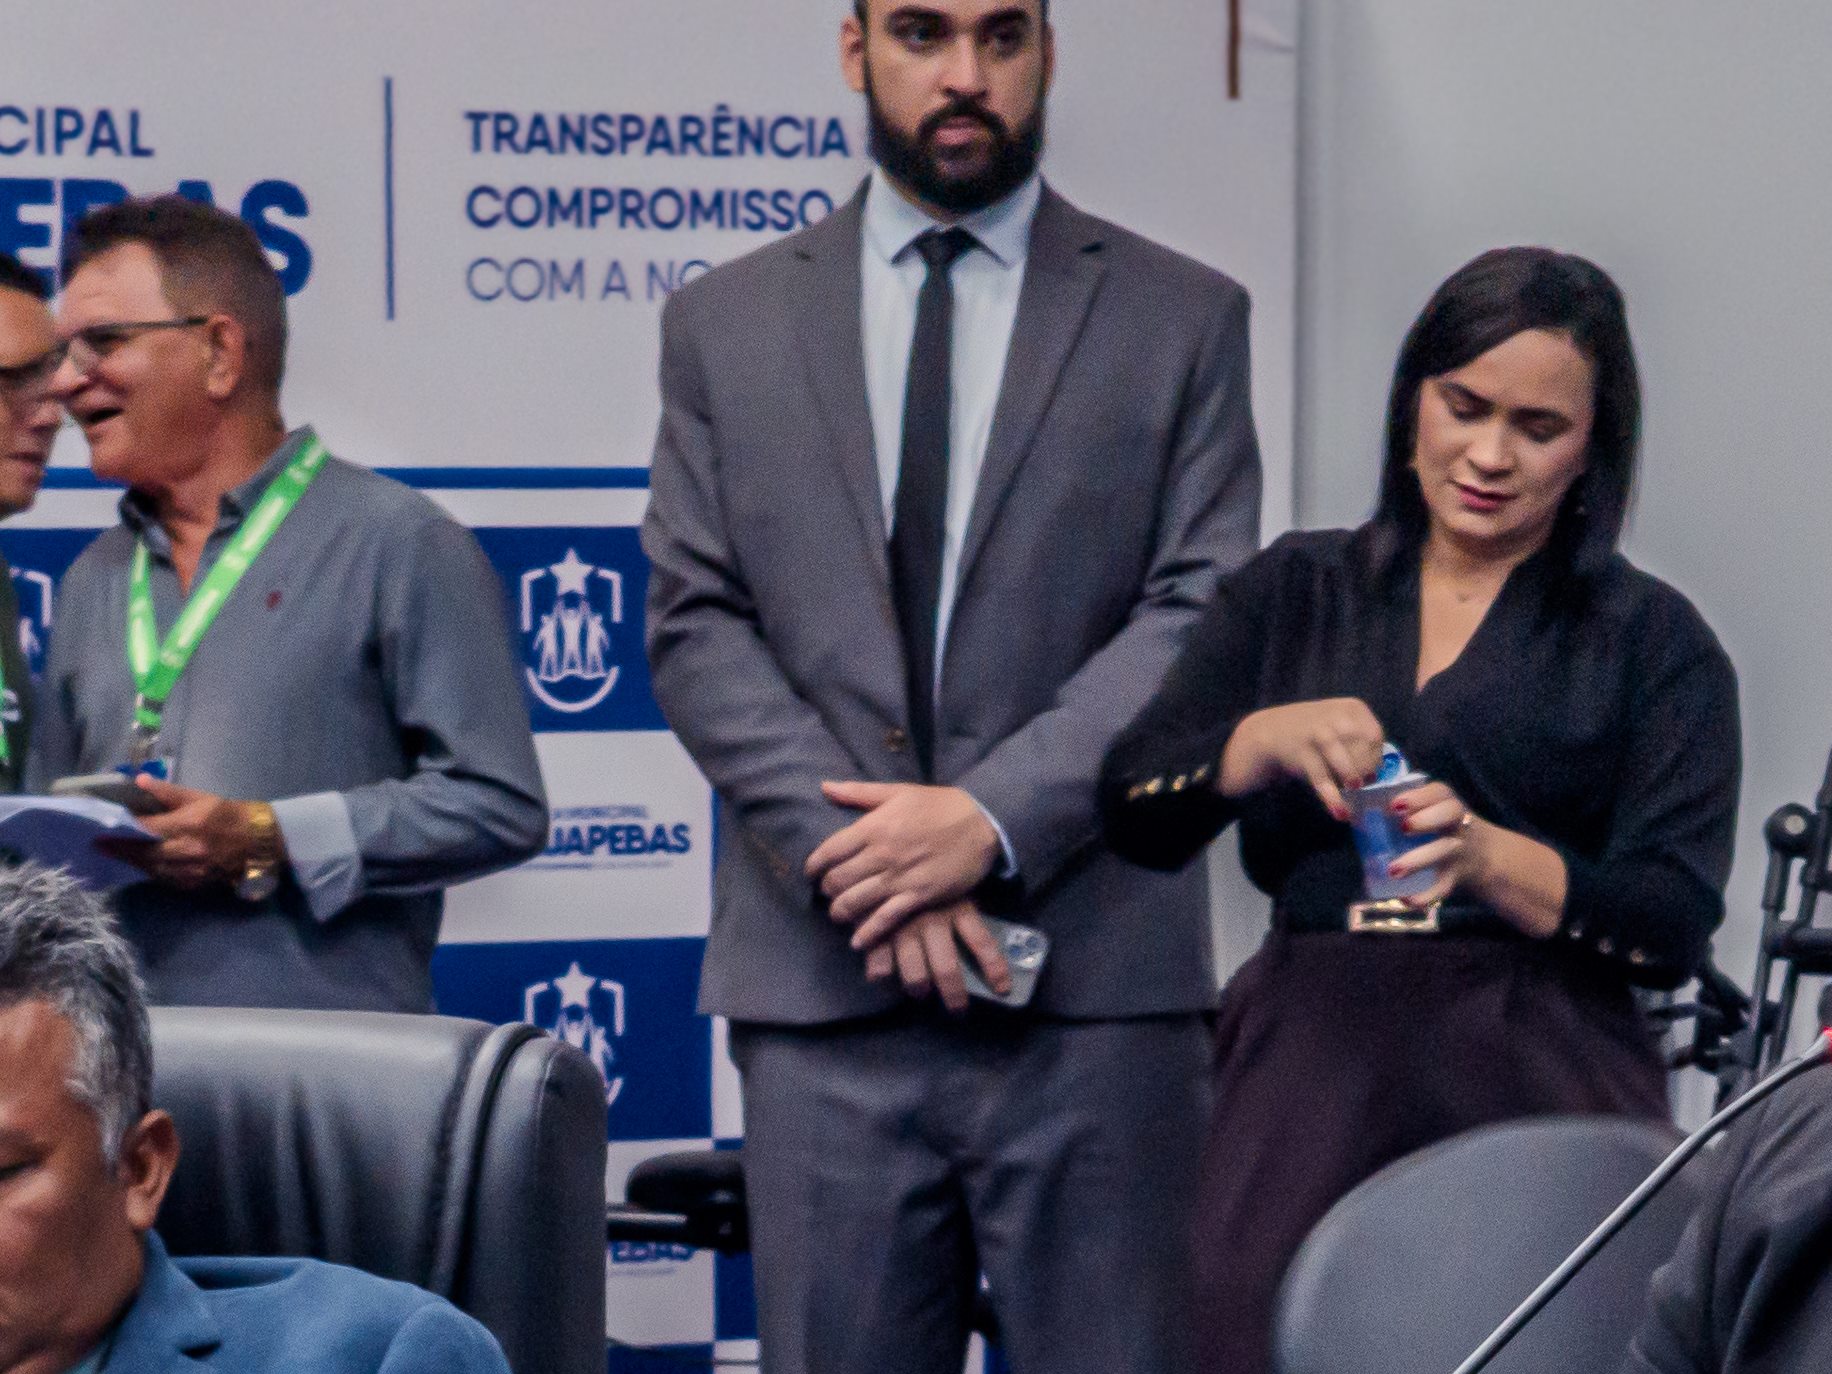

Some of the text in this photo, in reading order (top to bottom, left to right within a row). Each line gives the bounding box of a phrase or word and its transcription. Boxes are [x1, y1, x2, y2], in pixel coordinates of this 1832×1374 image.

[0, 105, 154, 157] CIPAL
[465, 104, 851, 158] TRANSPARÊNCIA
[466, 185, 834, 231] COMPROMISSO
[466, 256, 586, 301] COM
[601, 261, 633, 300] A
